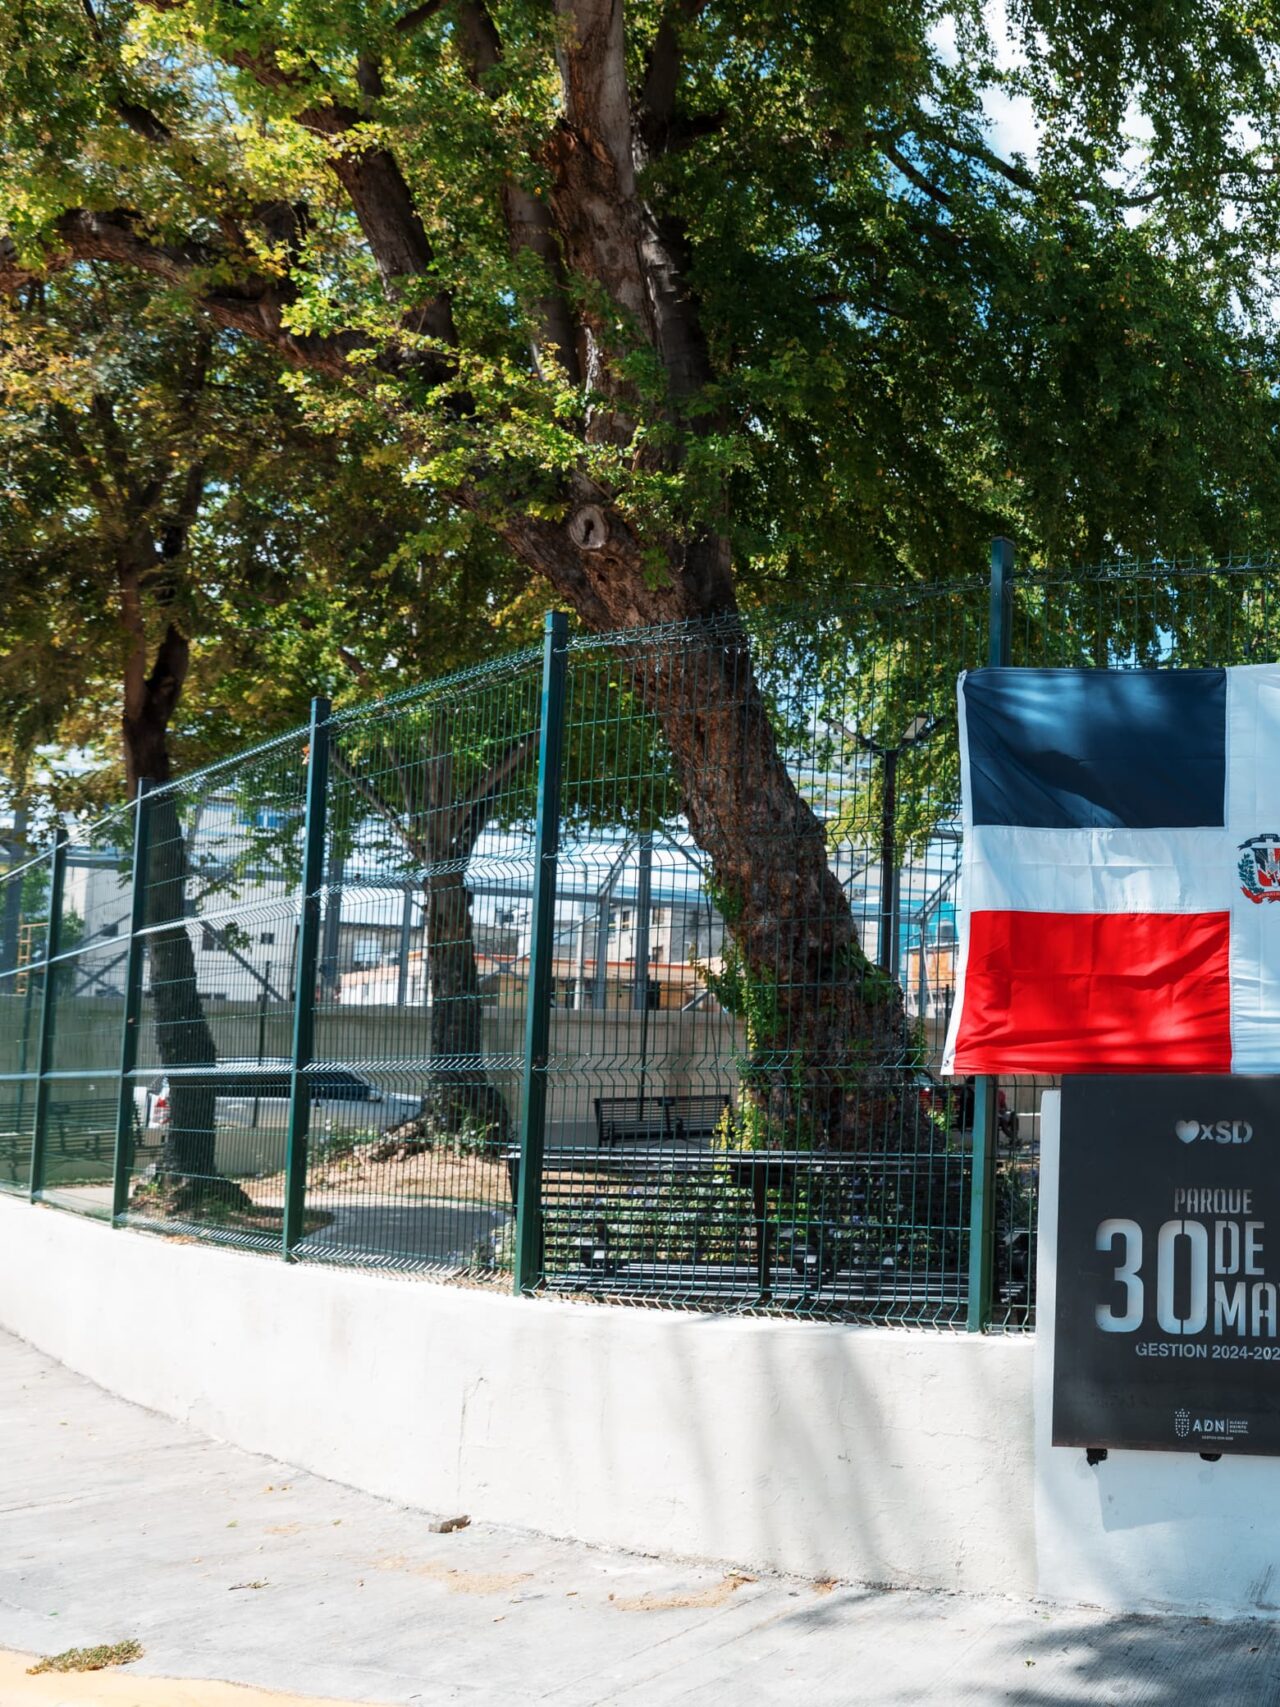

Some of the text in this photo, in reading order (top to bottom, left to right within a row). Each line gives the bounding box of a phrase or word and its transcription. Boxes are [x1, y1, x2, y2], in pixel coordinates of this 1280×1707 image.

[1174, 1187, 1253, 1215] PARQUE
[1095, 1218, 1265, 1335] 30 DE
[1135, 1342, 1207, 1359] GESTION
[1192, 1419, 1225, 1433] ADN
